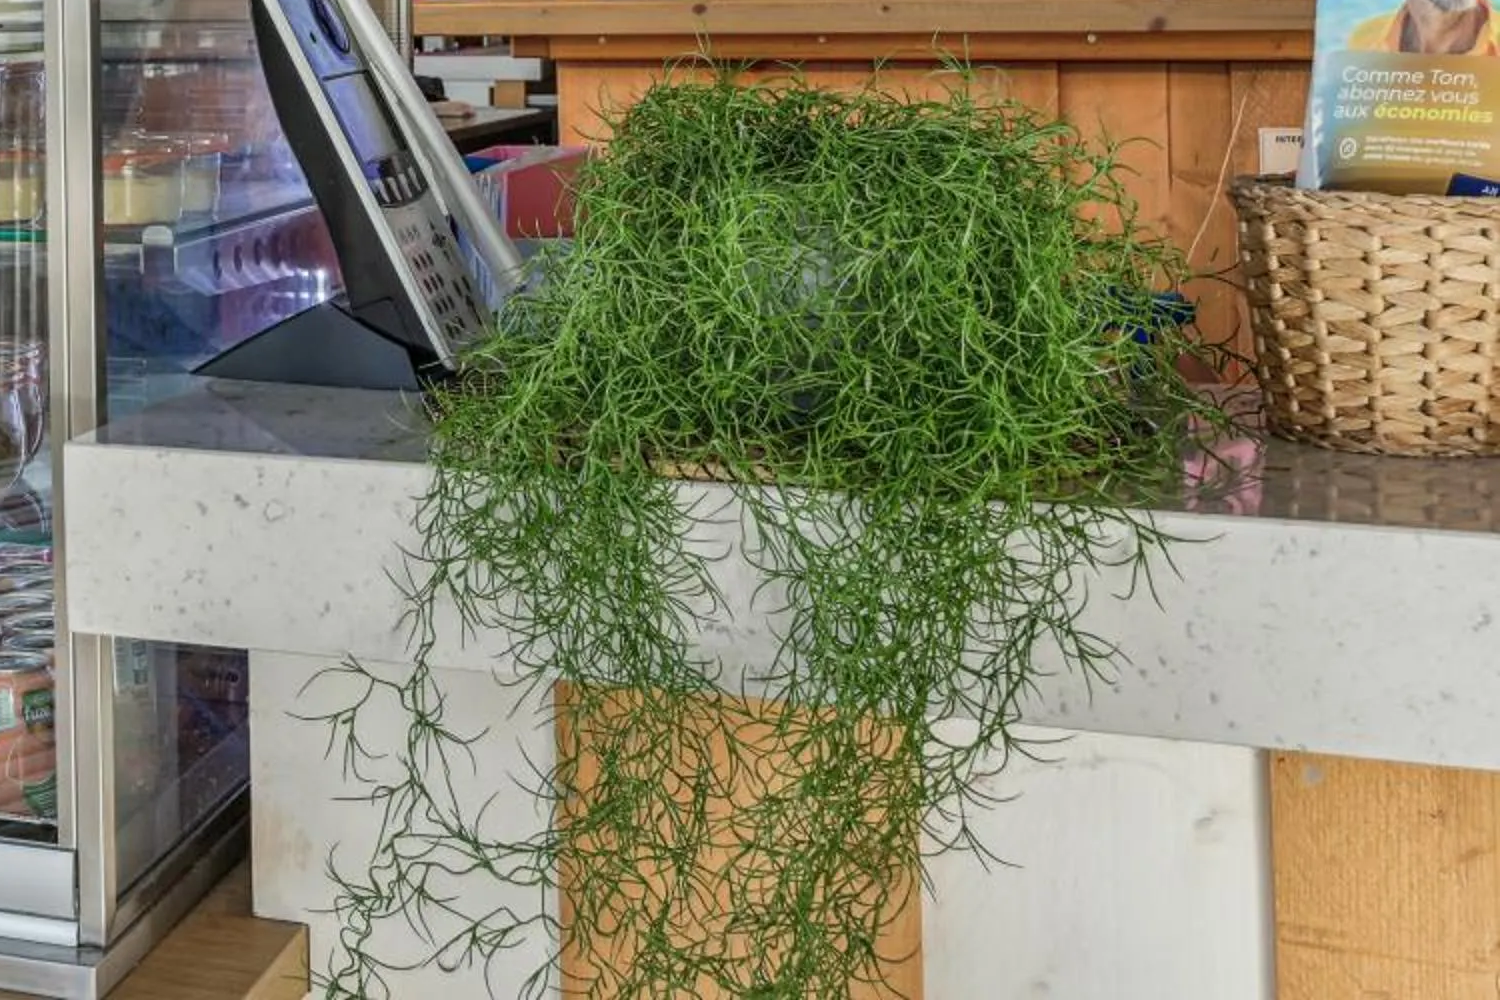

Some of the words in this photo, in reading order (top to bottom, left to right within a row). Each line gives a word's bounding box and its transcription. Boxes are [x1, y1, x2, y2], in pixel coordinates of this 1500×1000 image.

[1342, 65, 1425, 85] Comme
[1429, 68, 1479, 88] Tom,
[1336, 83, 1427, 104] abonnez
[1431, 89, 1481, 105] vous
[1333, 103, 1369, 119] aux
[1373, 101, 1494, 123] économies
